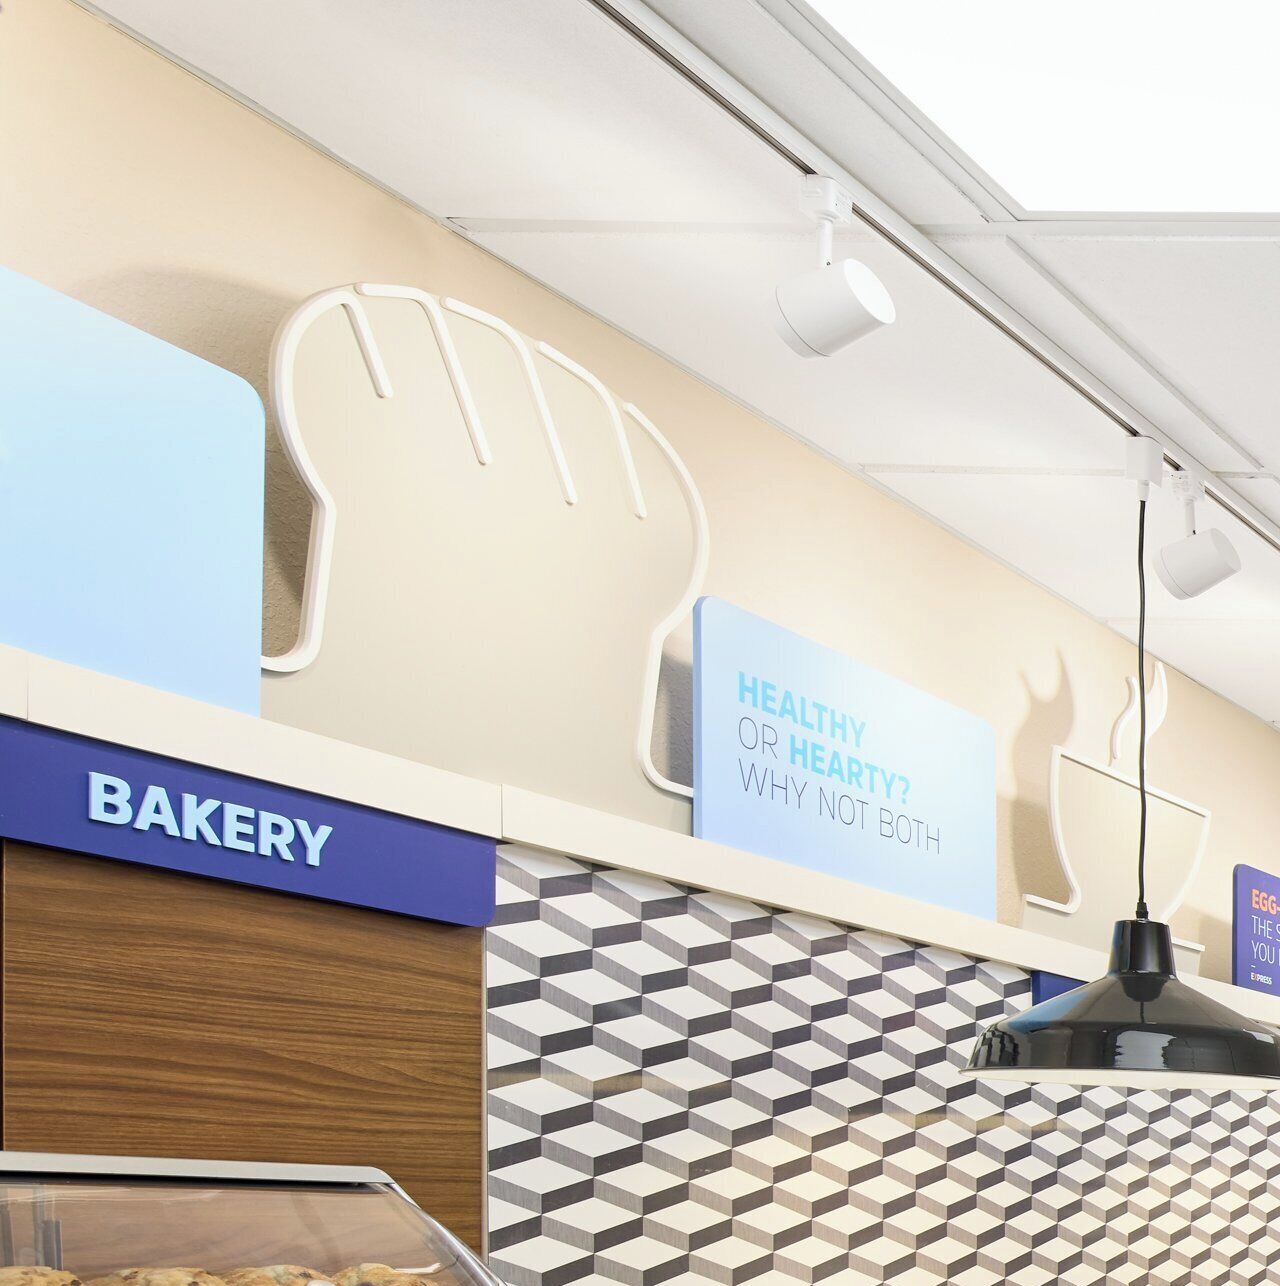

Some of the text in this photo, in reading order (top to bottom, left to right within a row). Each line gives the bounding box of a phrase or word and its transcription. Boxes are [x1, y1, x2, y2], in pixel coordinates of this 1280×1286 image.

[738, 670, 866, 748] HEALTHY
[738, 716, 911, 805] OR HEARTY?
[88, 771, 334, 867] BAKERY
[738, 757, 940, 854] WHY NOT BOTH
[1251, 915, 1273, 940] THE
[1251, 940, 1275, 964] YOU
[1250, 972, 1273, 985] EXPRESS
